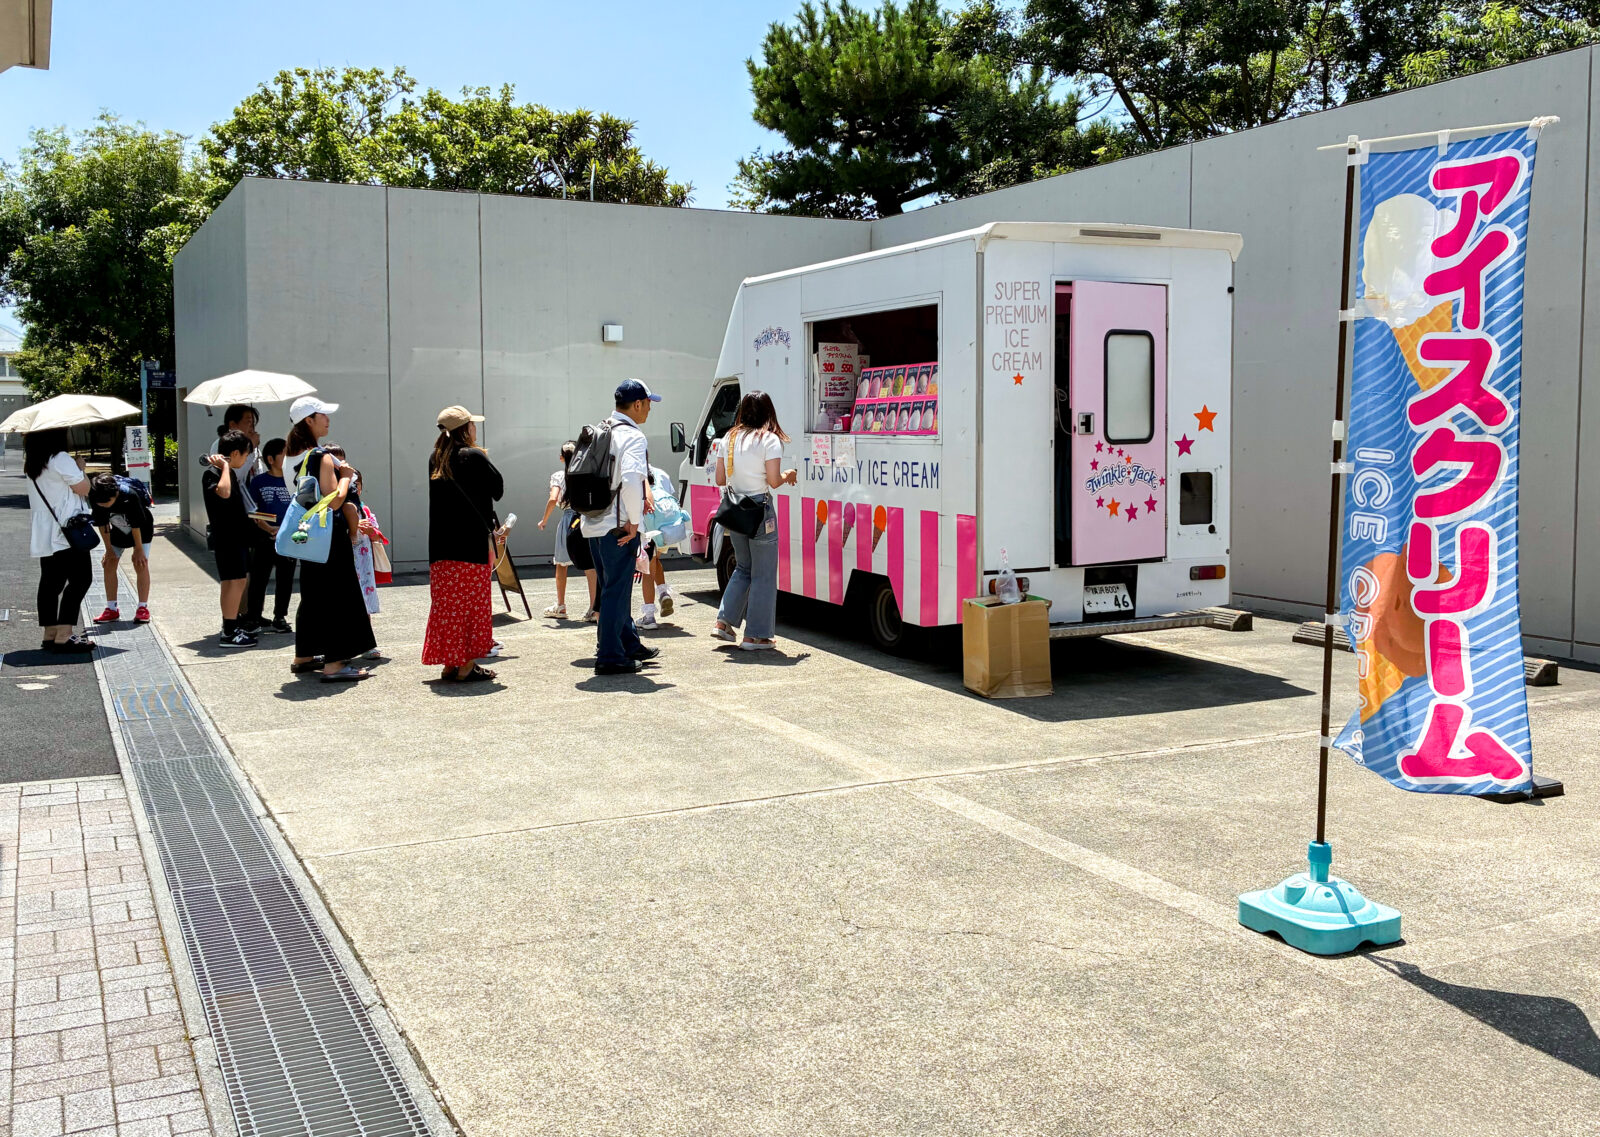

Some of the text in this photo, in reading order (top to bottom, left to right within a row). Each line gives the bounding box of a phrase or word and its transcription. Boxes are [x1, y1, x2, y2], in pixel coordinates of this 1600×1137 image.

[994, 281, 1041, 301] SUPER
[985, 304, 1047, 325] PREMIUM
[1004, 328, 1030, 349] ICE
[822, 362, 835, 373] 300
[841, 363, 854, 373] 550
[991, 351, 1042, 371] CREAM
[131, 428, 142, 448] 受付
[867, 459, 889, 486] ICE
[893, 460, 940, 490] CREAM
[1397, 150, 1530, 784] アイスクリーム
[1085, 463, 1158, 494] Twinkle Jack
[1349, 446, 1396, 545] ICE
